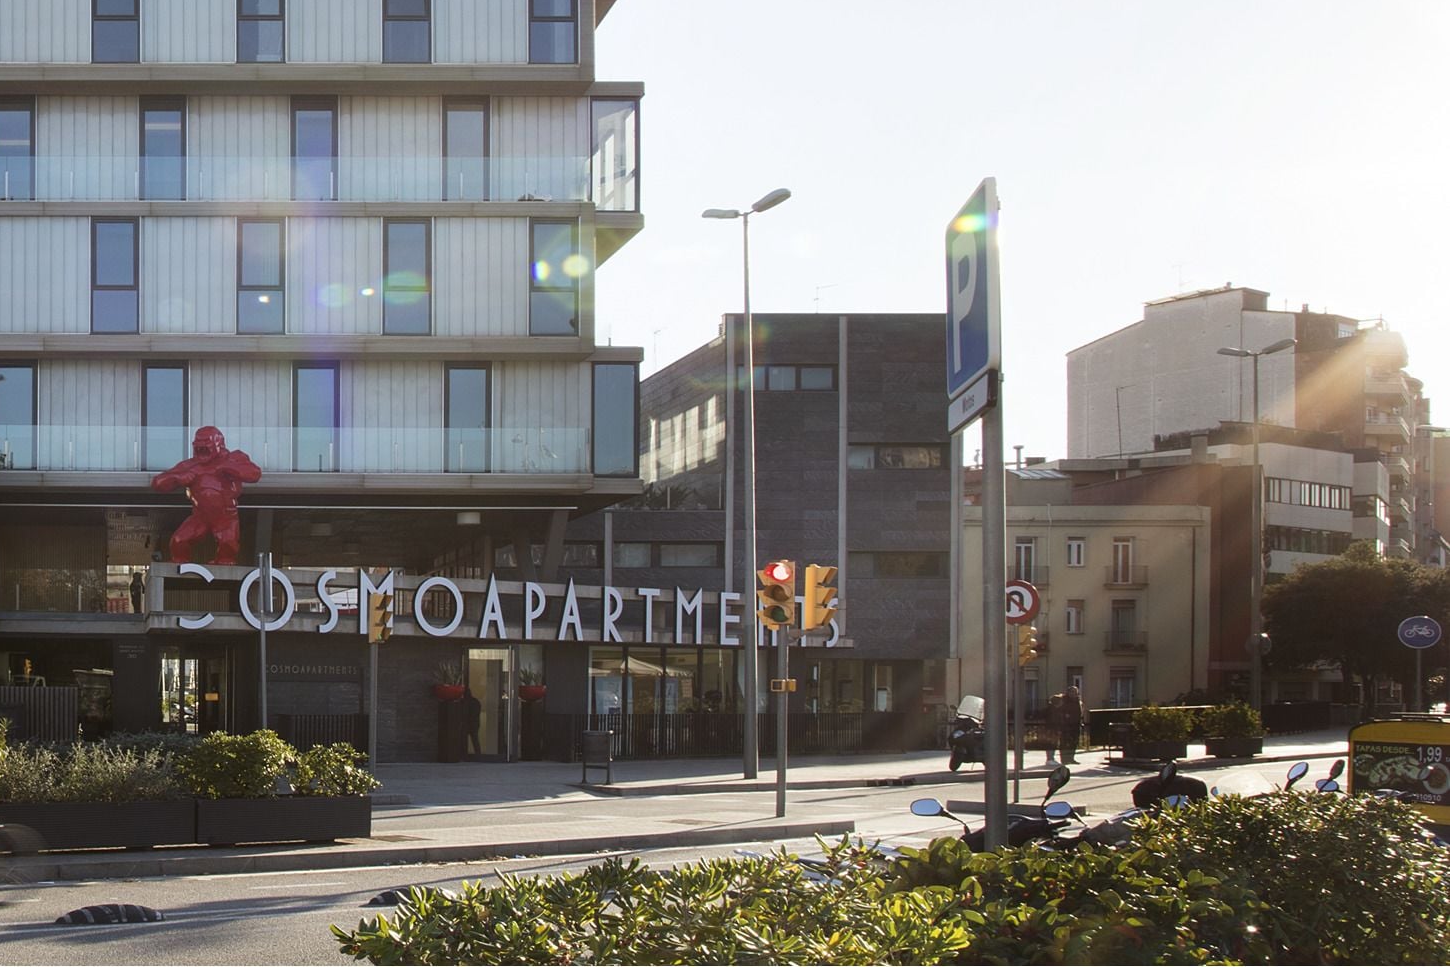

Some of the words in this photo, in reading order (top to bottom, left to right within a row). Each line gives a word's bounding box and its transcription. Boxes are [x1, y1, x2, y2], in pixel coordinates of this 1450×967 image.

[951, 230, 978, 374] P
[1355, 745, 1382, 753] TAPAS
[1416, 746, 1443, 763] 1,99
